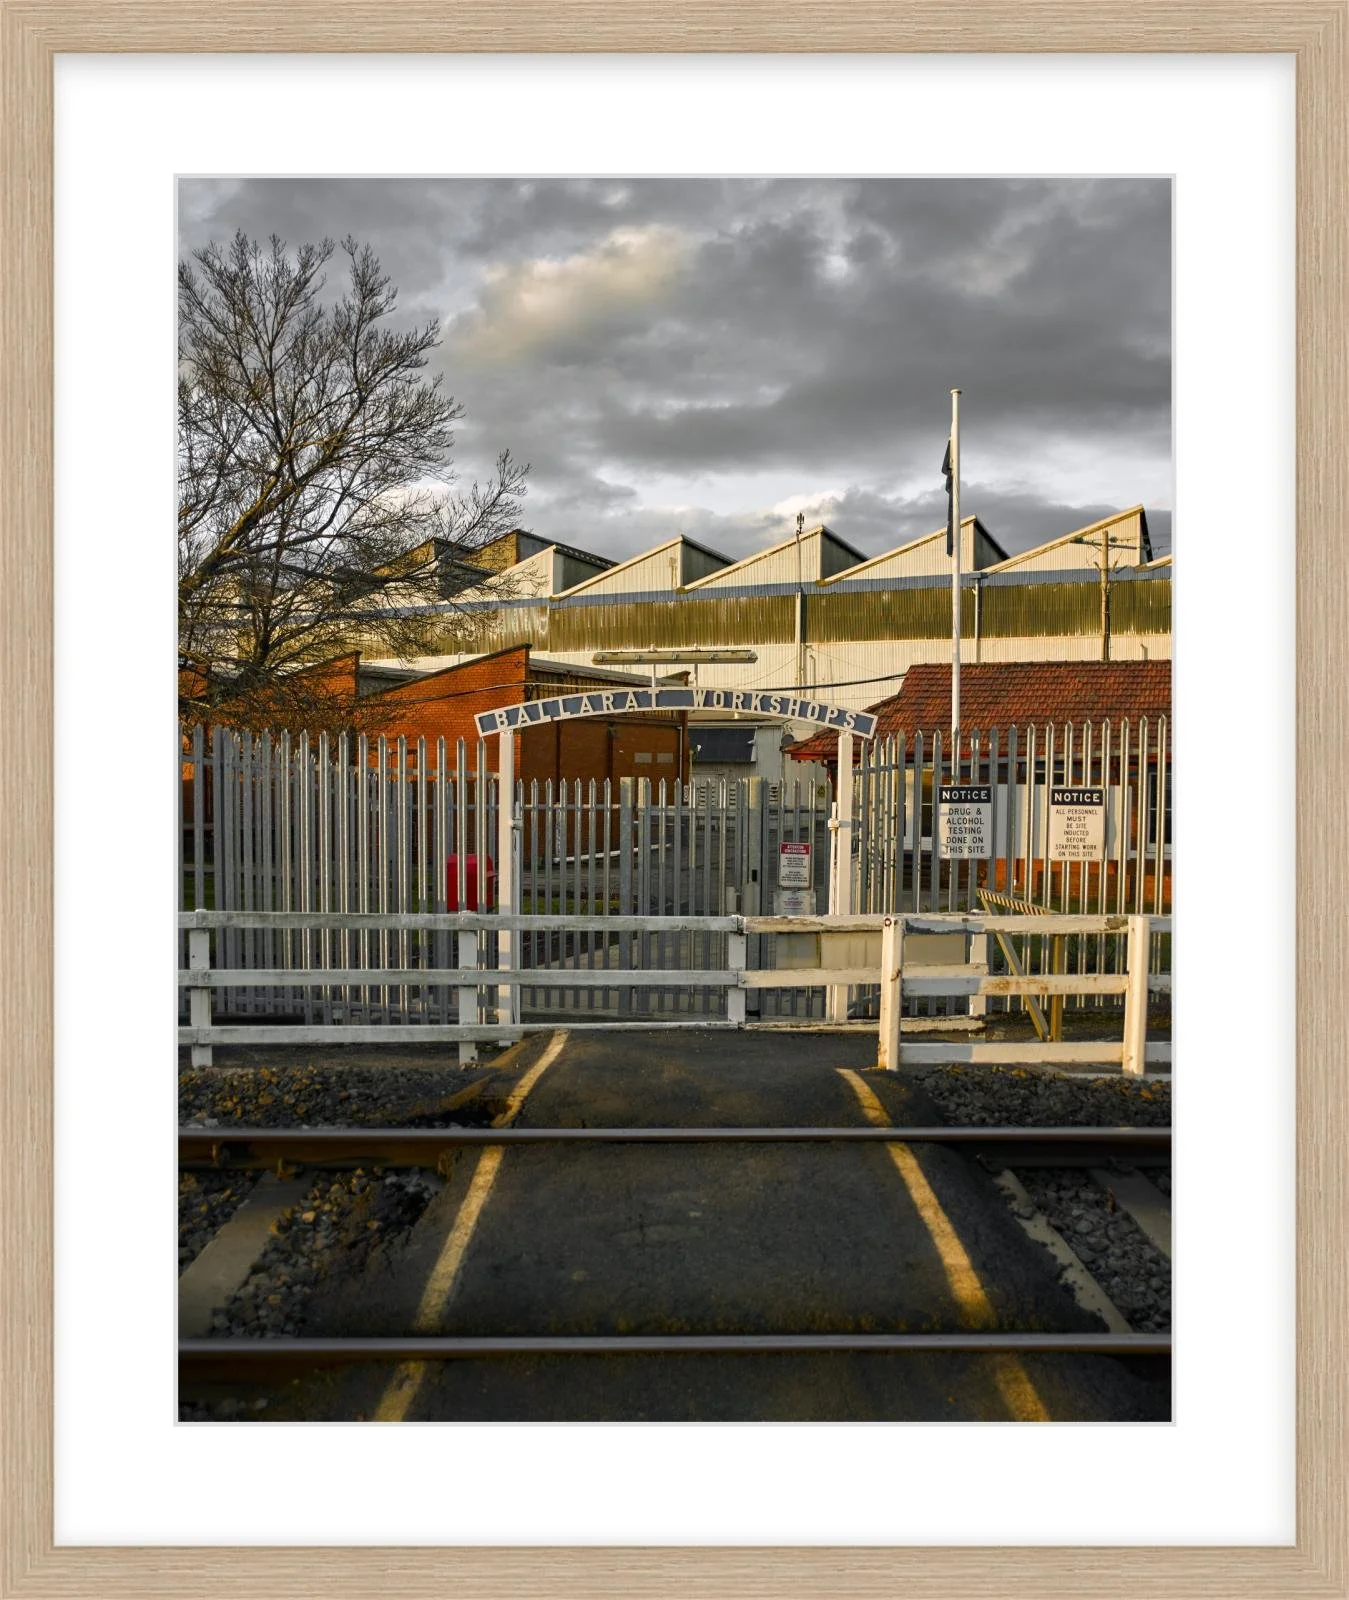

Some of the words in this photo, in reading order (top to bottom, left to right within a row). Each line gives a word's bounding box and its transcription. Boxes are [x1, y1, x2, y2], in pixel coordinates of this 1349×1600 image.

[494, 689, 660, 730] BALLARAT
[692, 690, 857, 730] WORKSHOPS
[942, 790, 988, 800] NOTICE
[1054, 792, 1100, 802] NOTICE
[948, 807, 971, 816] DRUG
[976, 807, 982, 816] &
[946, 817, 984, 825] ALCOHOL
[948, 826, 982, 835] TESTING
[946, 836, 968, 844] DONE
[972, 836, 984, 844] ON
[945, 845, 963, 854] THIS
[967, 845, 985, 854] SITE
